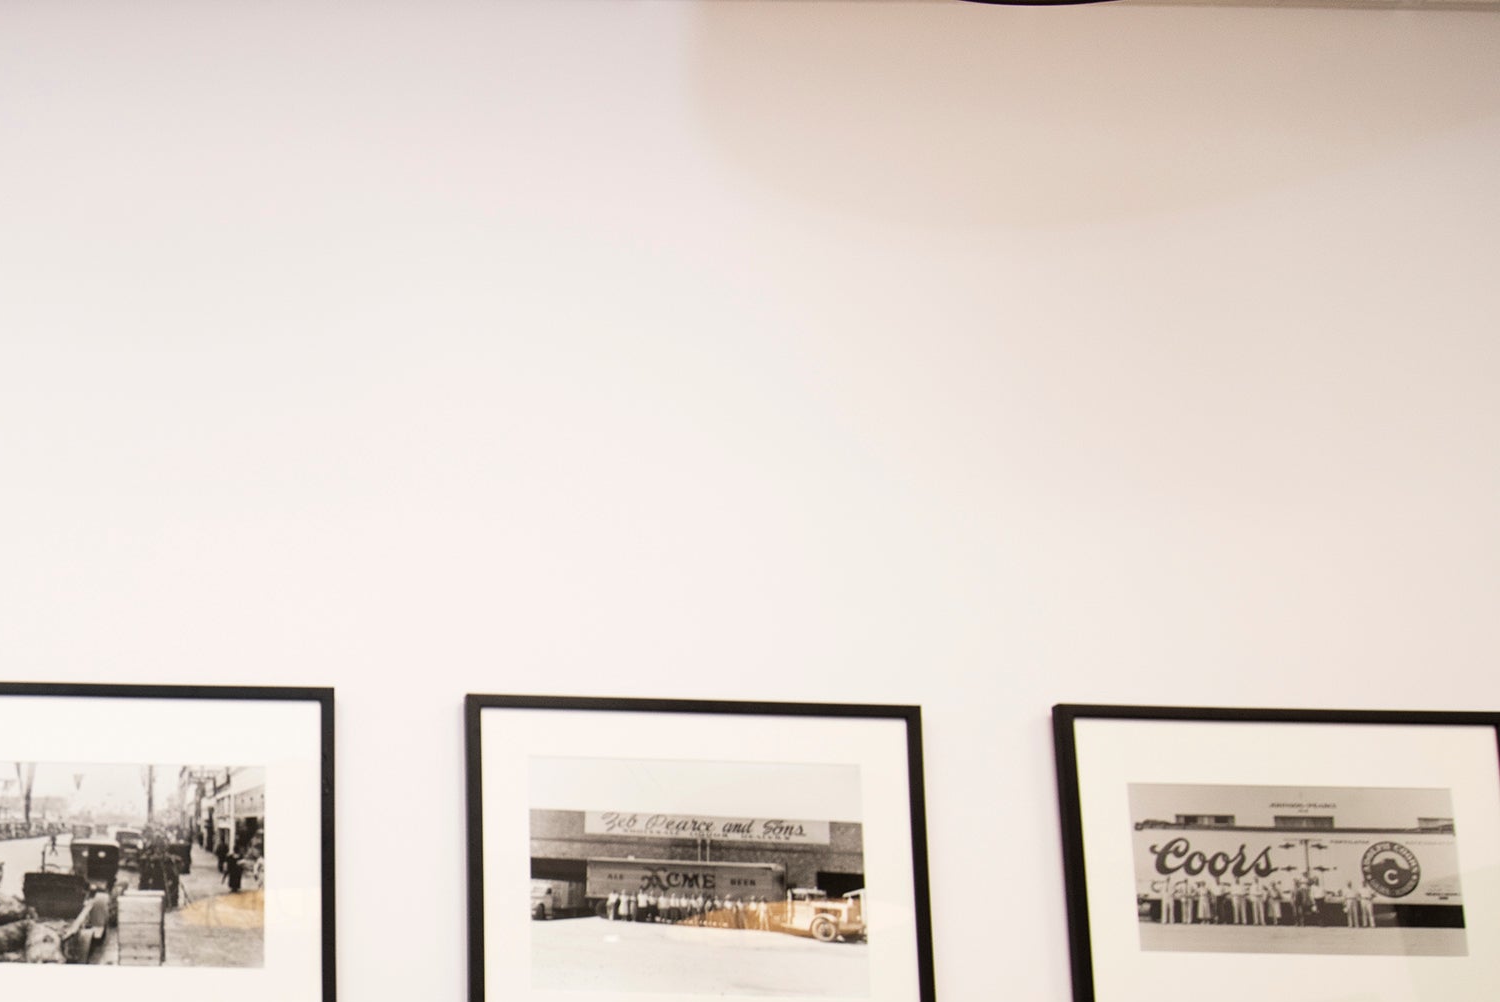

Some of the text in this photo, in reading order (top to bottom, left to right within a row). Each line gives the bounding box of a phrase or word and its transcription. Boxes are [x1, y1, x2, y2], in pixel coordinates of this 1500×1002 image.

[645, 814, 713, 832] Pearce
[722, 820, 755, 834] and
[763, 819, 807, 837] Sons
[1149, 837, 1279, 878] Coors
[639, 866, 716, 891] ACME
